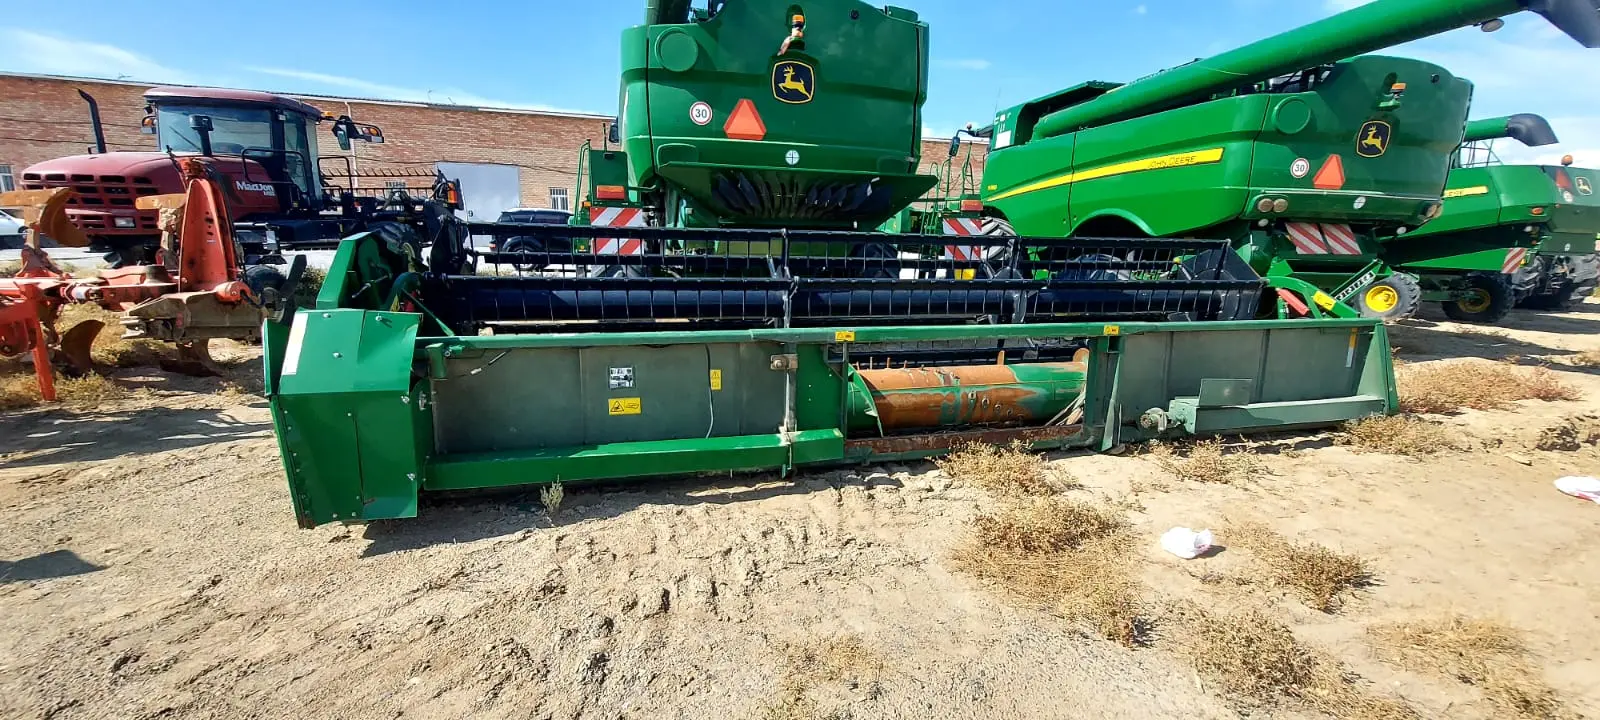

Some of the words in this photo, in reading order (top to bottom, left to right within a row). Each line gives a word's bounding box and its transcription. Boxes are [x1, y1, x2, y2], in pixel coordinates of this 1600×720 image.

[695, 109, 708, 119] 30
[1169, 155, 1197, 165] DEERE
[1295, 164, 1305, 172] 30
